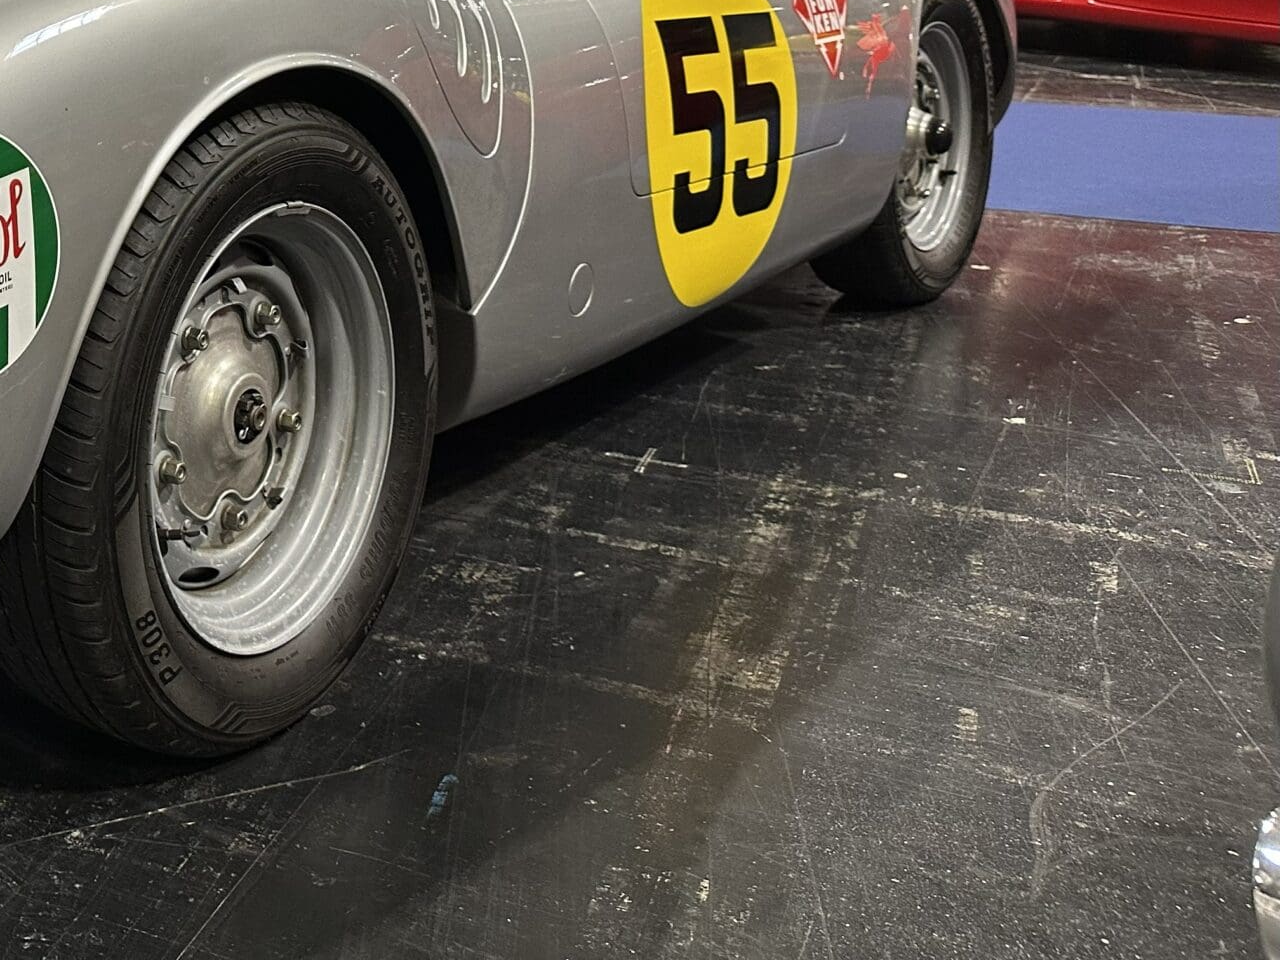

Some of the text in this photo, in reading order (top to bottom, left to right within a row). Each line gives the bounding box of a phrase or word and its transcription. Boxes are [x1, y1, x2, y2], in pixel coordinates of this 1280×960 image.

[814, 12, 840, 33] KEN
[655, 12, 781, 234] 55
[136, 609, 183, 686] P308
